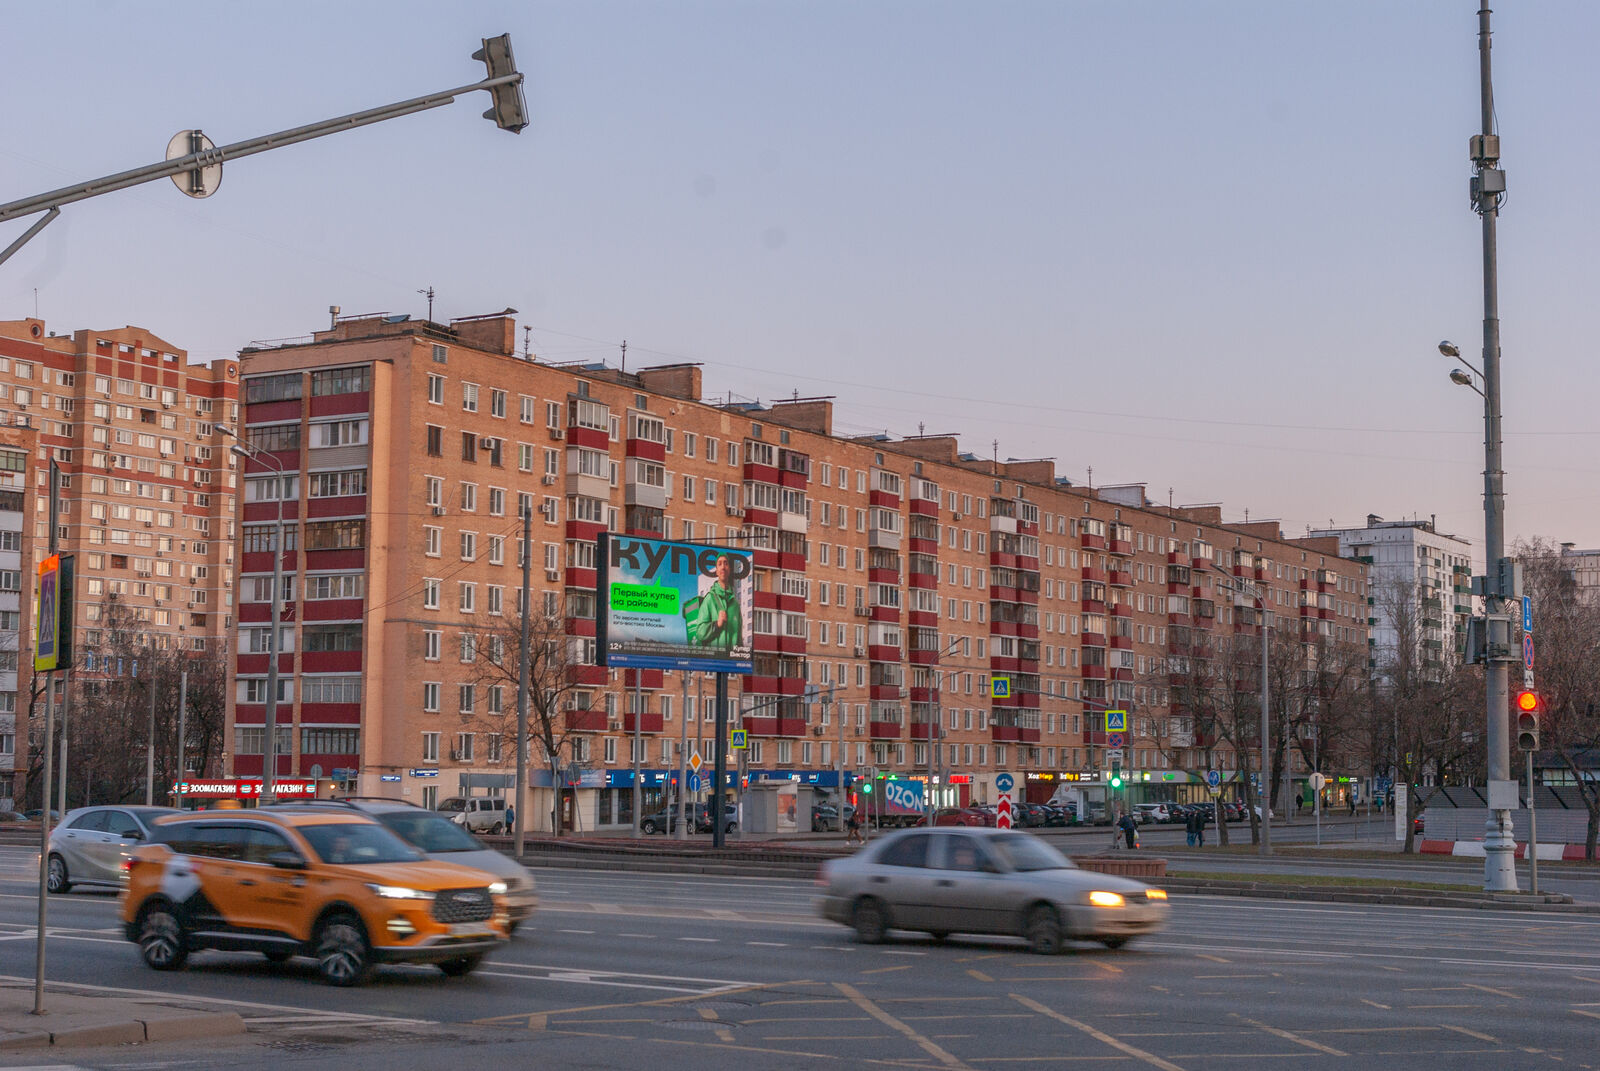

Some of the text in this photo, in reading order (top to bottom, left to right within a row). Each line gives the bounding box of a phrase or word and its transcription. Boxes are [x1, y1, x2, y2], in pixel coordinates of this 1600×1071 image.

[613, 587, 676, 602] Первый купер
[627, 599, 659, 609] районе
[190, 784, 236, 793] ЗООМАГАЗИН
[885, 782, 924, 812] OZON
